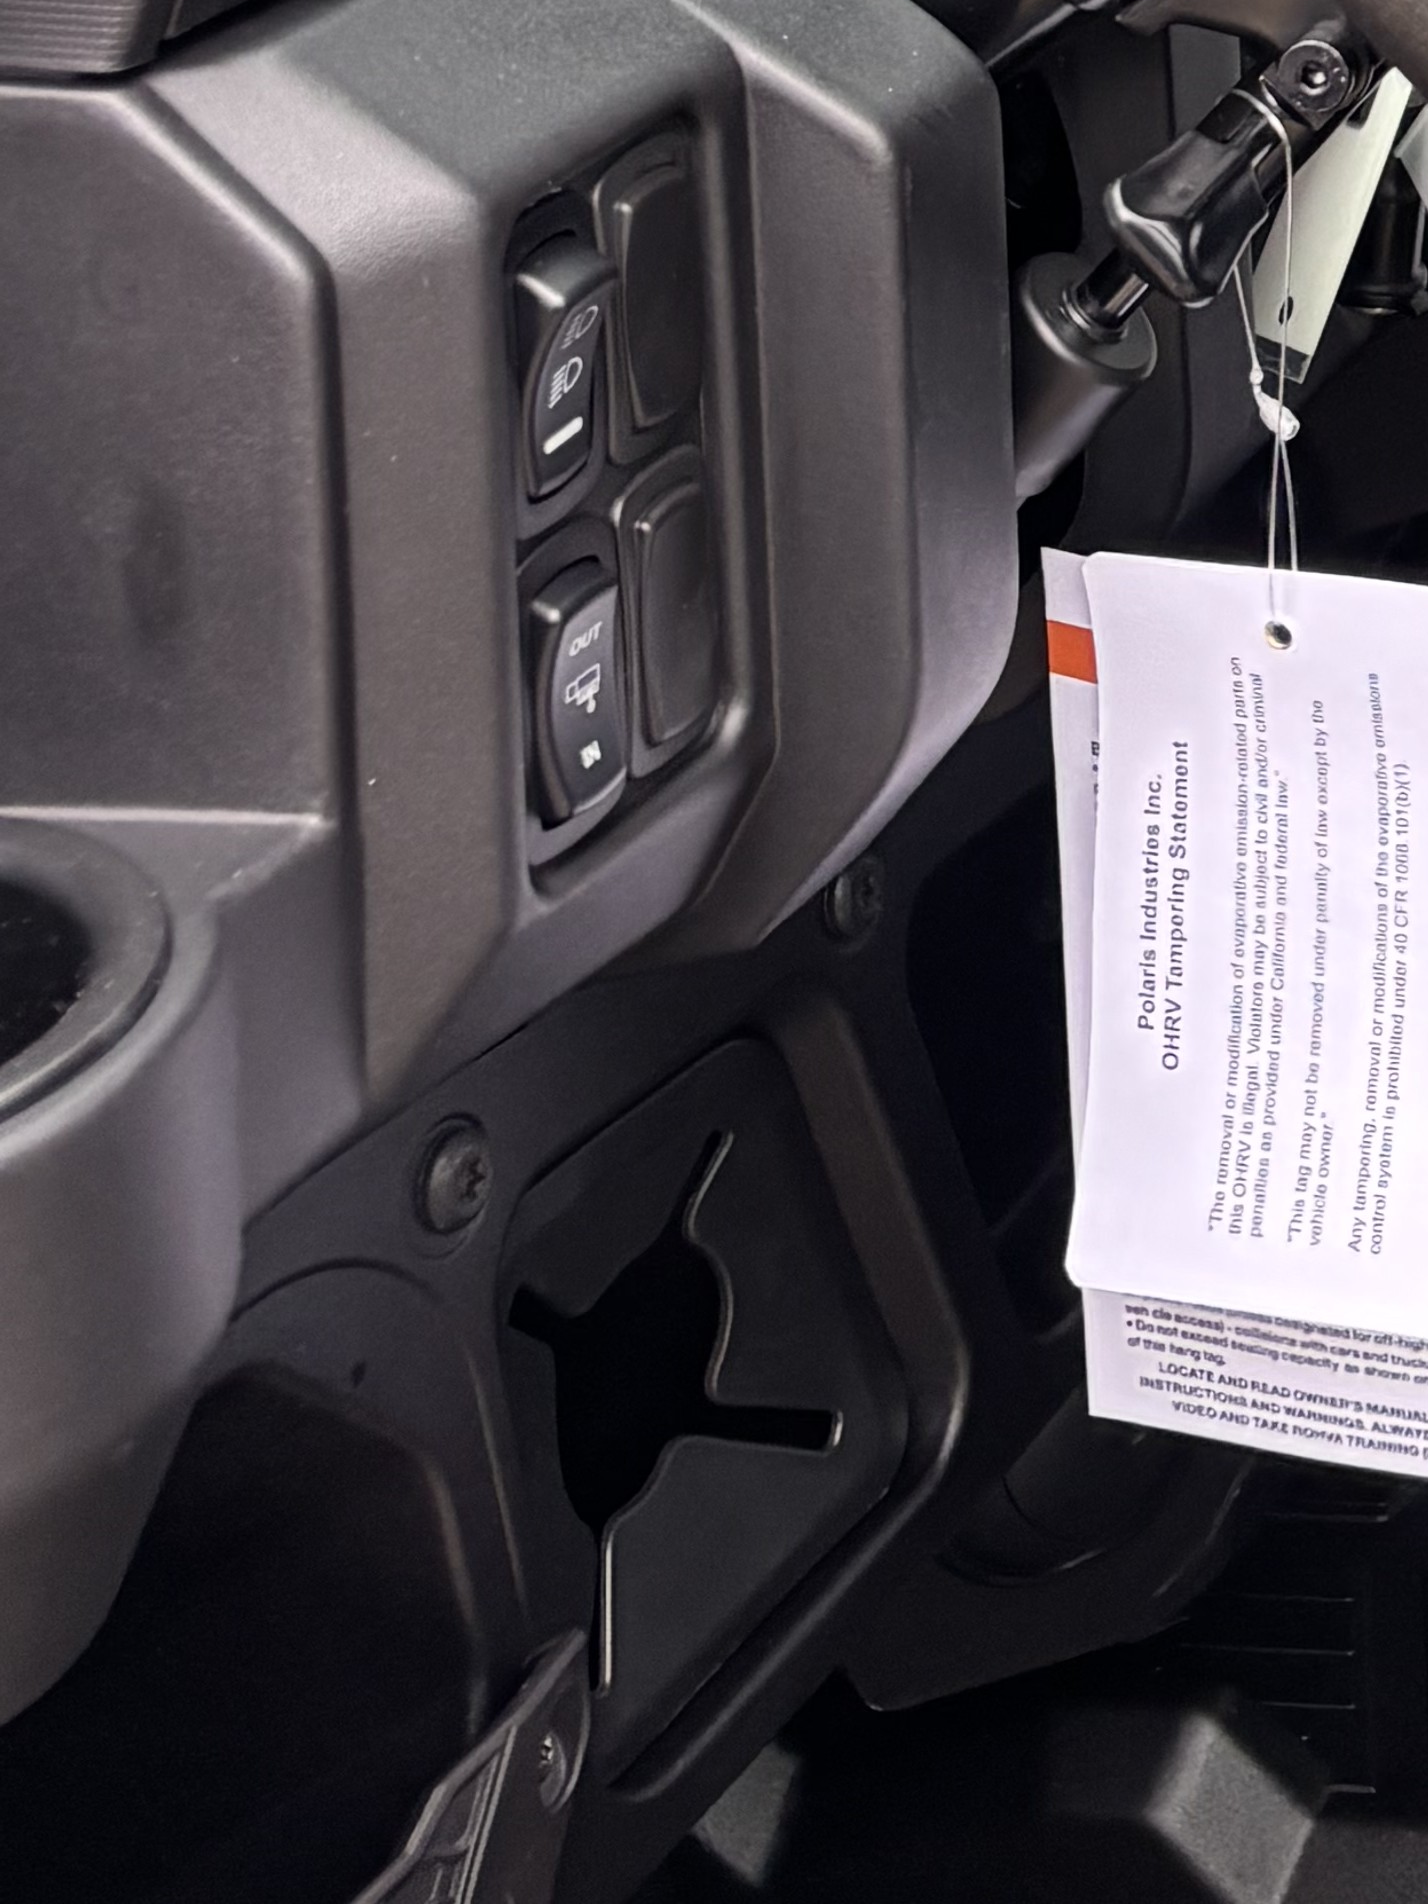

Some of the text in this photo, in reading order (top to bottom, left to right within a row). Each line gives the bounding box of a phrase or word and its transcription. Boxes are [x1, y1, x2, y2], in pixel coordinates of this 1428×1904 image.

[569, 621, 603, 657] OUT
[1229, 656, 1243, 677] on
[1231, 679, 1250, 720] parts
[1246, 672, 1268, 734] criminal
[1310, 699, 1326, 724] the
[1367, 672, 1387, 749] emissions
[1312, 727, 1330, 748] by
[1254, 737, 1270, 789] and/or
[1314, 750, 1331, 806] except
[1254, 792, 1269, 825] civil
[1374, 752, 1392, 847] evaporative
[1253, 828, 1269, 845] to
[1314, 808, 1329, 838] law
[1313, 840, 1329, 859] of
[1375, 850, 1389, 878] the
[1252, 849, 1271, 910] subject
[1373, 880, 1389, 899] of
[1136, 774, 1163, 1031] Polaris Industries Inc.
[1161, 740, 1191, 1071] OHRV Tampering Statement
[1232, 861, 1249, 959] evaporative
[1252, 913, 1267, 936] be
[1229, 961, 1245, 980] of
[1253, 939, 1270, 977] may
[1312, 927, 1327, 978] under
[1371, 903, 1389, 1015] modifications
[1226, 983, 1244, 1087] modification
[1245, 980, 1265, 1055] Violators
[1249, 812, 1290, 1239] penalties as provided under California and federal
[1309, 981, 1326, 1057] removed
[1371, 1017, 1384, 1037] or
[1304, 1061, 1321, 1085] be
[1364, 1040, 1382, 1112] removal
[1369, 889, 1409, 1256] control system is prohibited under 40 CFR
[1224, 1091, 1237, 1110] or
[1303, 1088, 1319, 1117] not
[1238, 1120, 1255, 1136] is
[1299, 1121, 1318, 1161] may
[1216, 1113, 1235, 1186] removal
[1231, 1139, 1252, 1199] OHRV
[1294, 1164, 1313, 1193] tag
[1227, 1203, 1245, 1235] this
[1309, 1183, 1328, 1247] vehicle
[1346, 1216, 1368, 1253] Any
[1157, 1361, 1216, 1384] LOCATE
[1216, 1373, 1249, 1390] AND
[1249, 1379, 1292, 1399] READ
[1171, 1399, 1219, 1420] VIDEO
[1218, 1409, 1251, 1427] AND
[1249, 1397, 1282, 1415] AND
